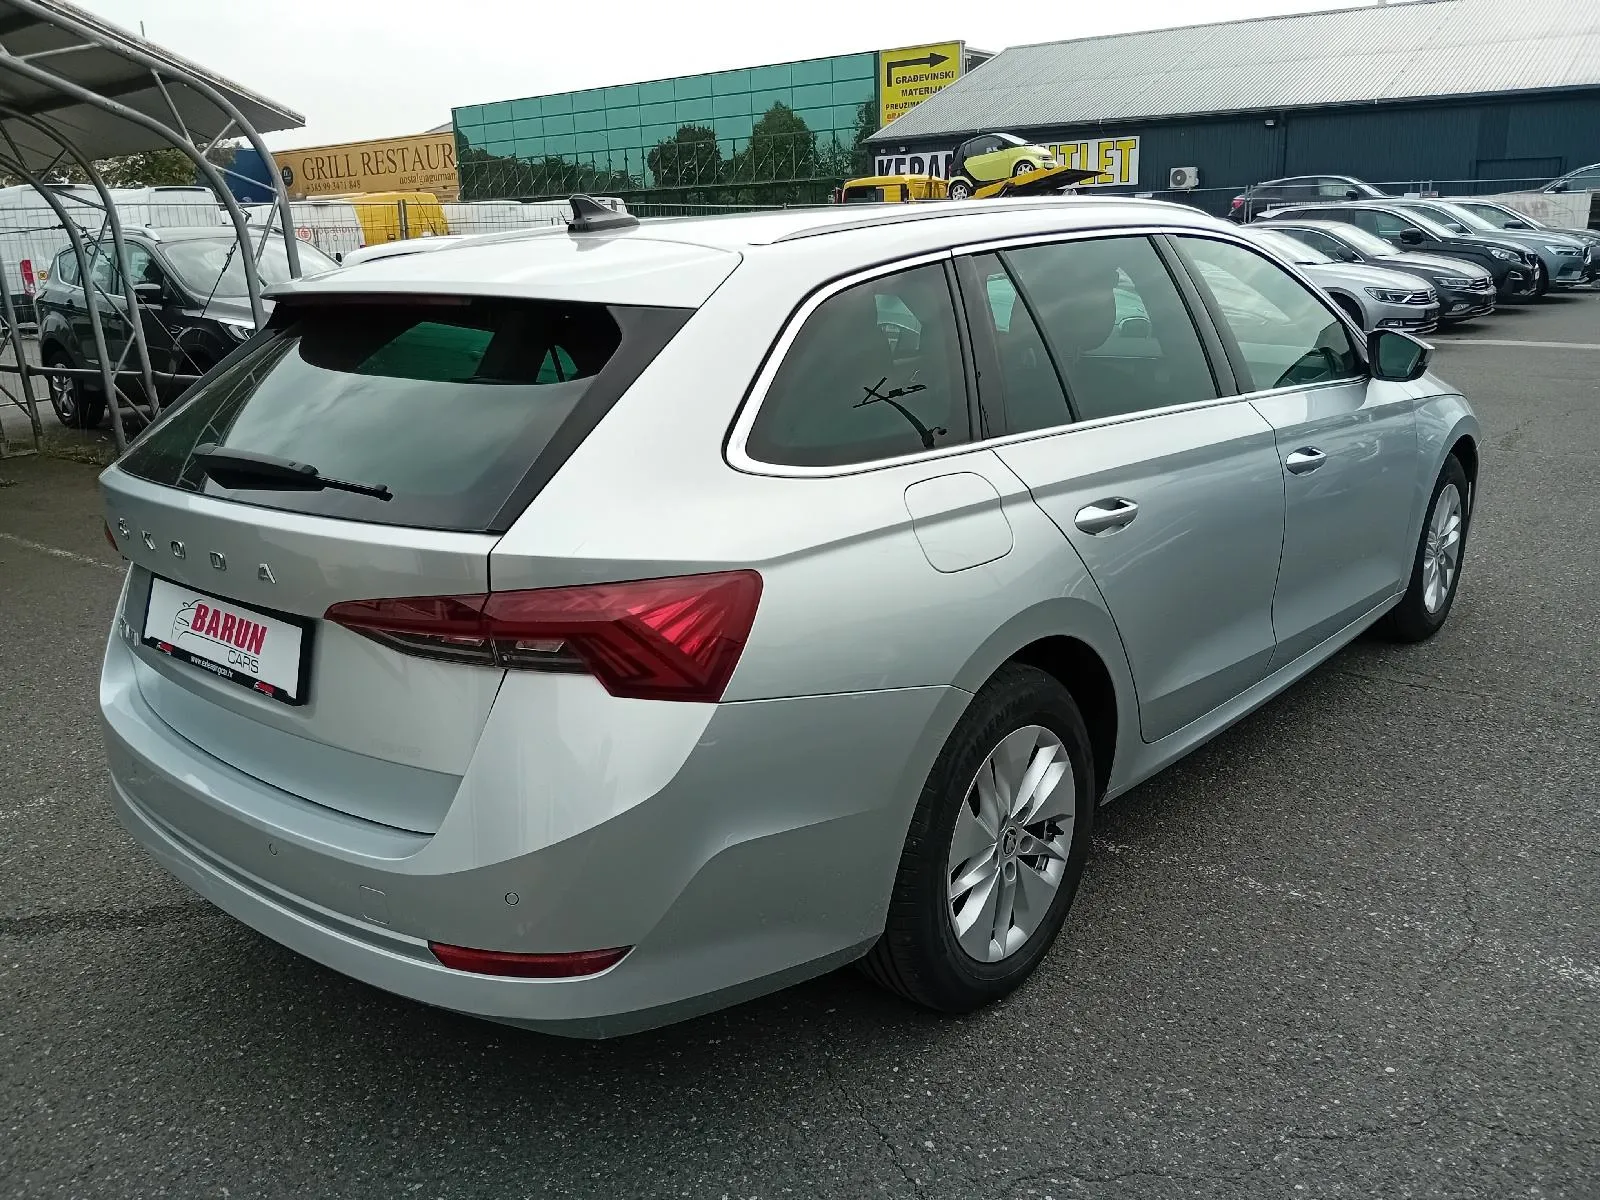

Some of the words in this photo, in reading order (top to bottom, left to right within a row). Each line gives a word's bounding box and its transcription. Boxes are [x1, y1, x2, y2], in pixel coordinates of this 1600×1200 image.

[895, 70, 955, 85] GRAĐEVINSKI
[302, 154, 358, 182] GRILL
[360, 142, 458, 177] RESTAUR
[322, 182, 331, 191] 99
[190, 602, 268, 656] BARUN
[227, 649, 260, 674] CARS
